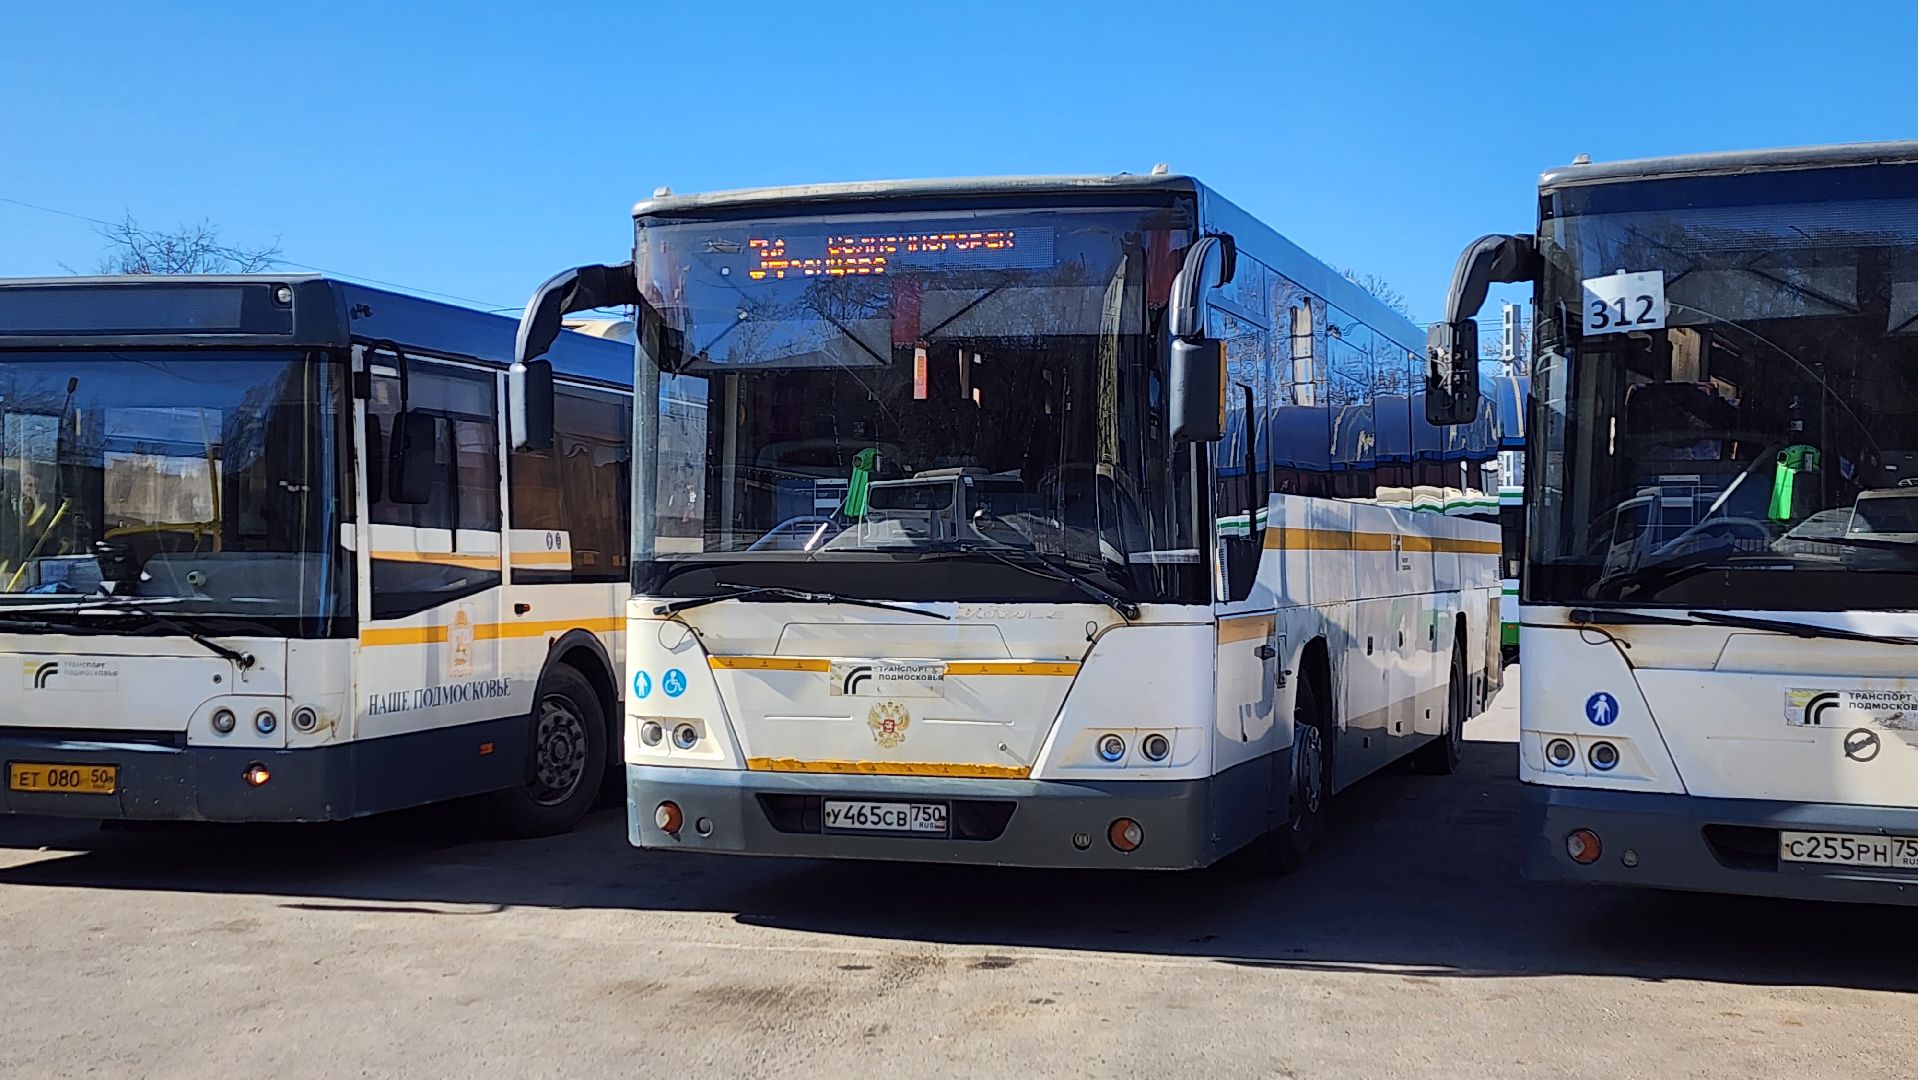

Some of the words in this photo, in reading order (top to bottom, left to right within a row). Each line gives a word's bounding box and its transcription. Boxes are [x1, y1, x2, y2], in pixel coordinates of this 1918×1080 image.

[1591, 294, 1656, 329] 312
[368, 690, 410, 716] НАШЕ
[413, 677, 512, 710] ПОДМОСКОВЬЕ
[1849, 692, 1912, 701] ТРАНСПОРТ
[48, 769, 80, 788] 080
[91, 768, 108, 783] 50
[911, 805, 942, 821] 750
[919, 821, 934, 829] RUS
